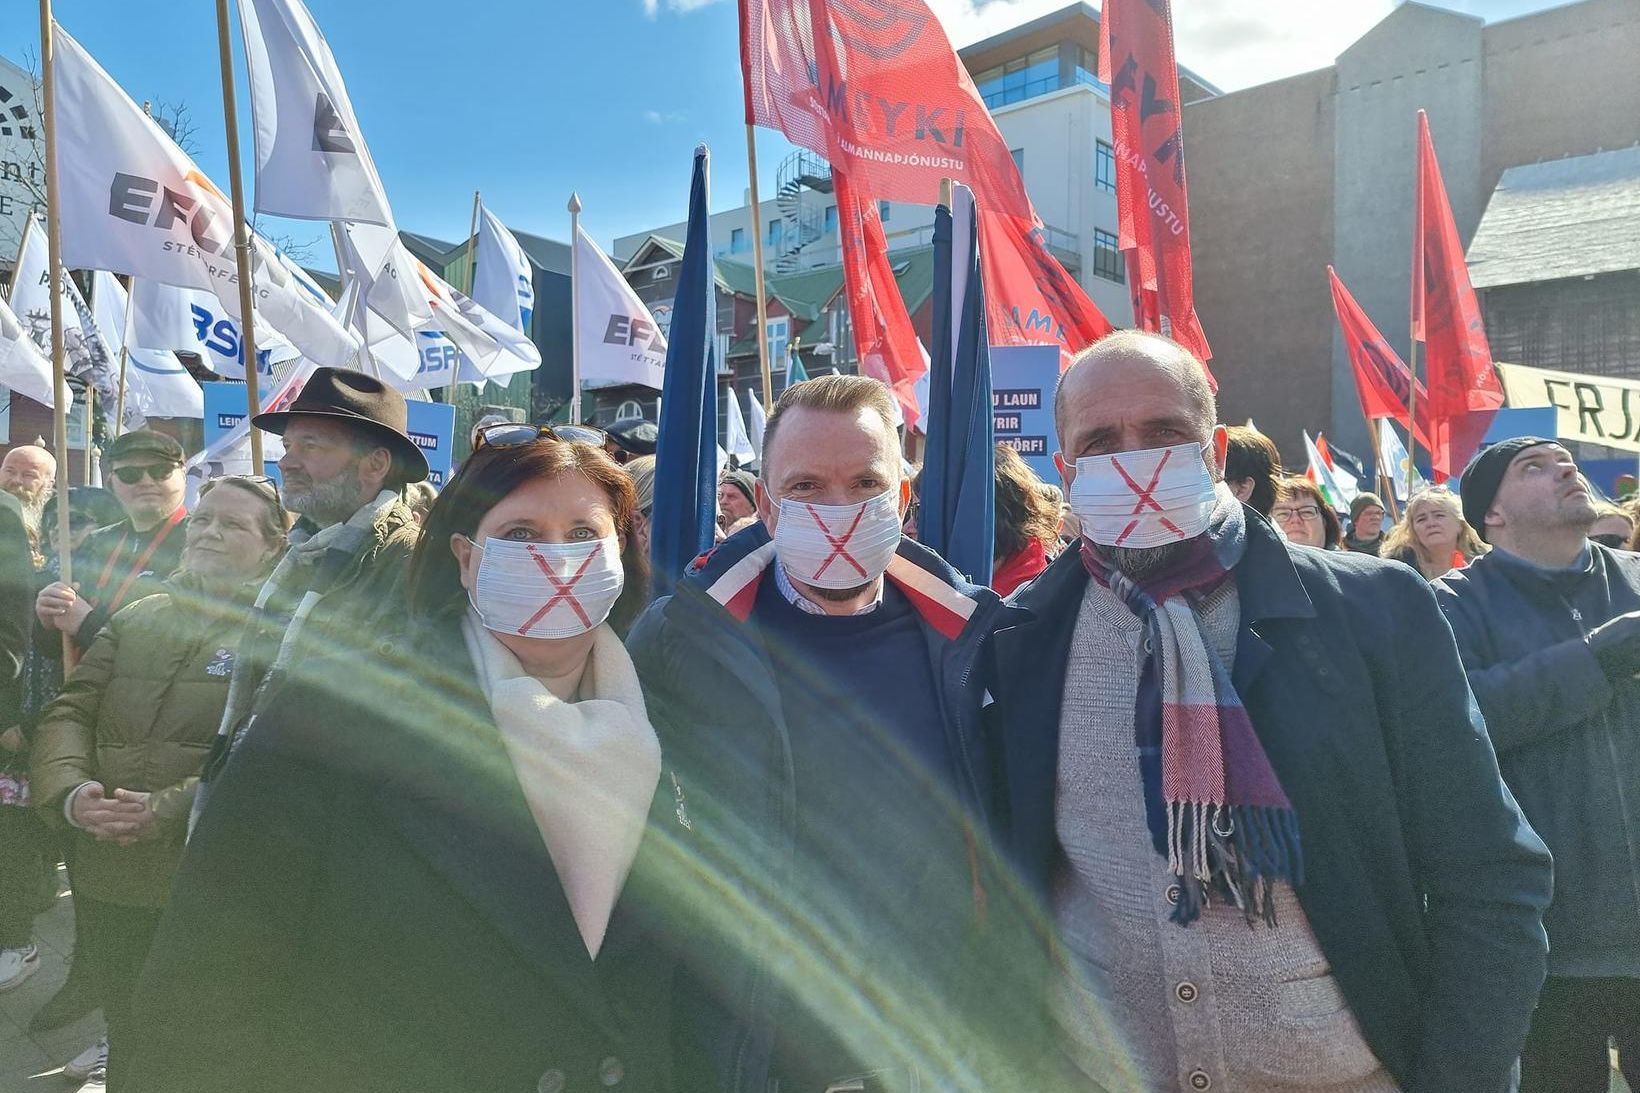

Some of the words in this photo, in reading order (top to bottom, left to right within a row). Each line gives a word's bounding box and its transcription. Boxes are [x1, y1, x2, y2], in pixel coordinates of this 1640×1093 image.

[1003, 393, 1038, 406] LAUN
[1544, 378, 1640, 443] FRJ
[993, 417, 1019, 430] RIR
